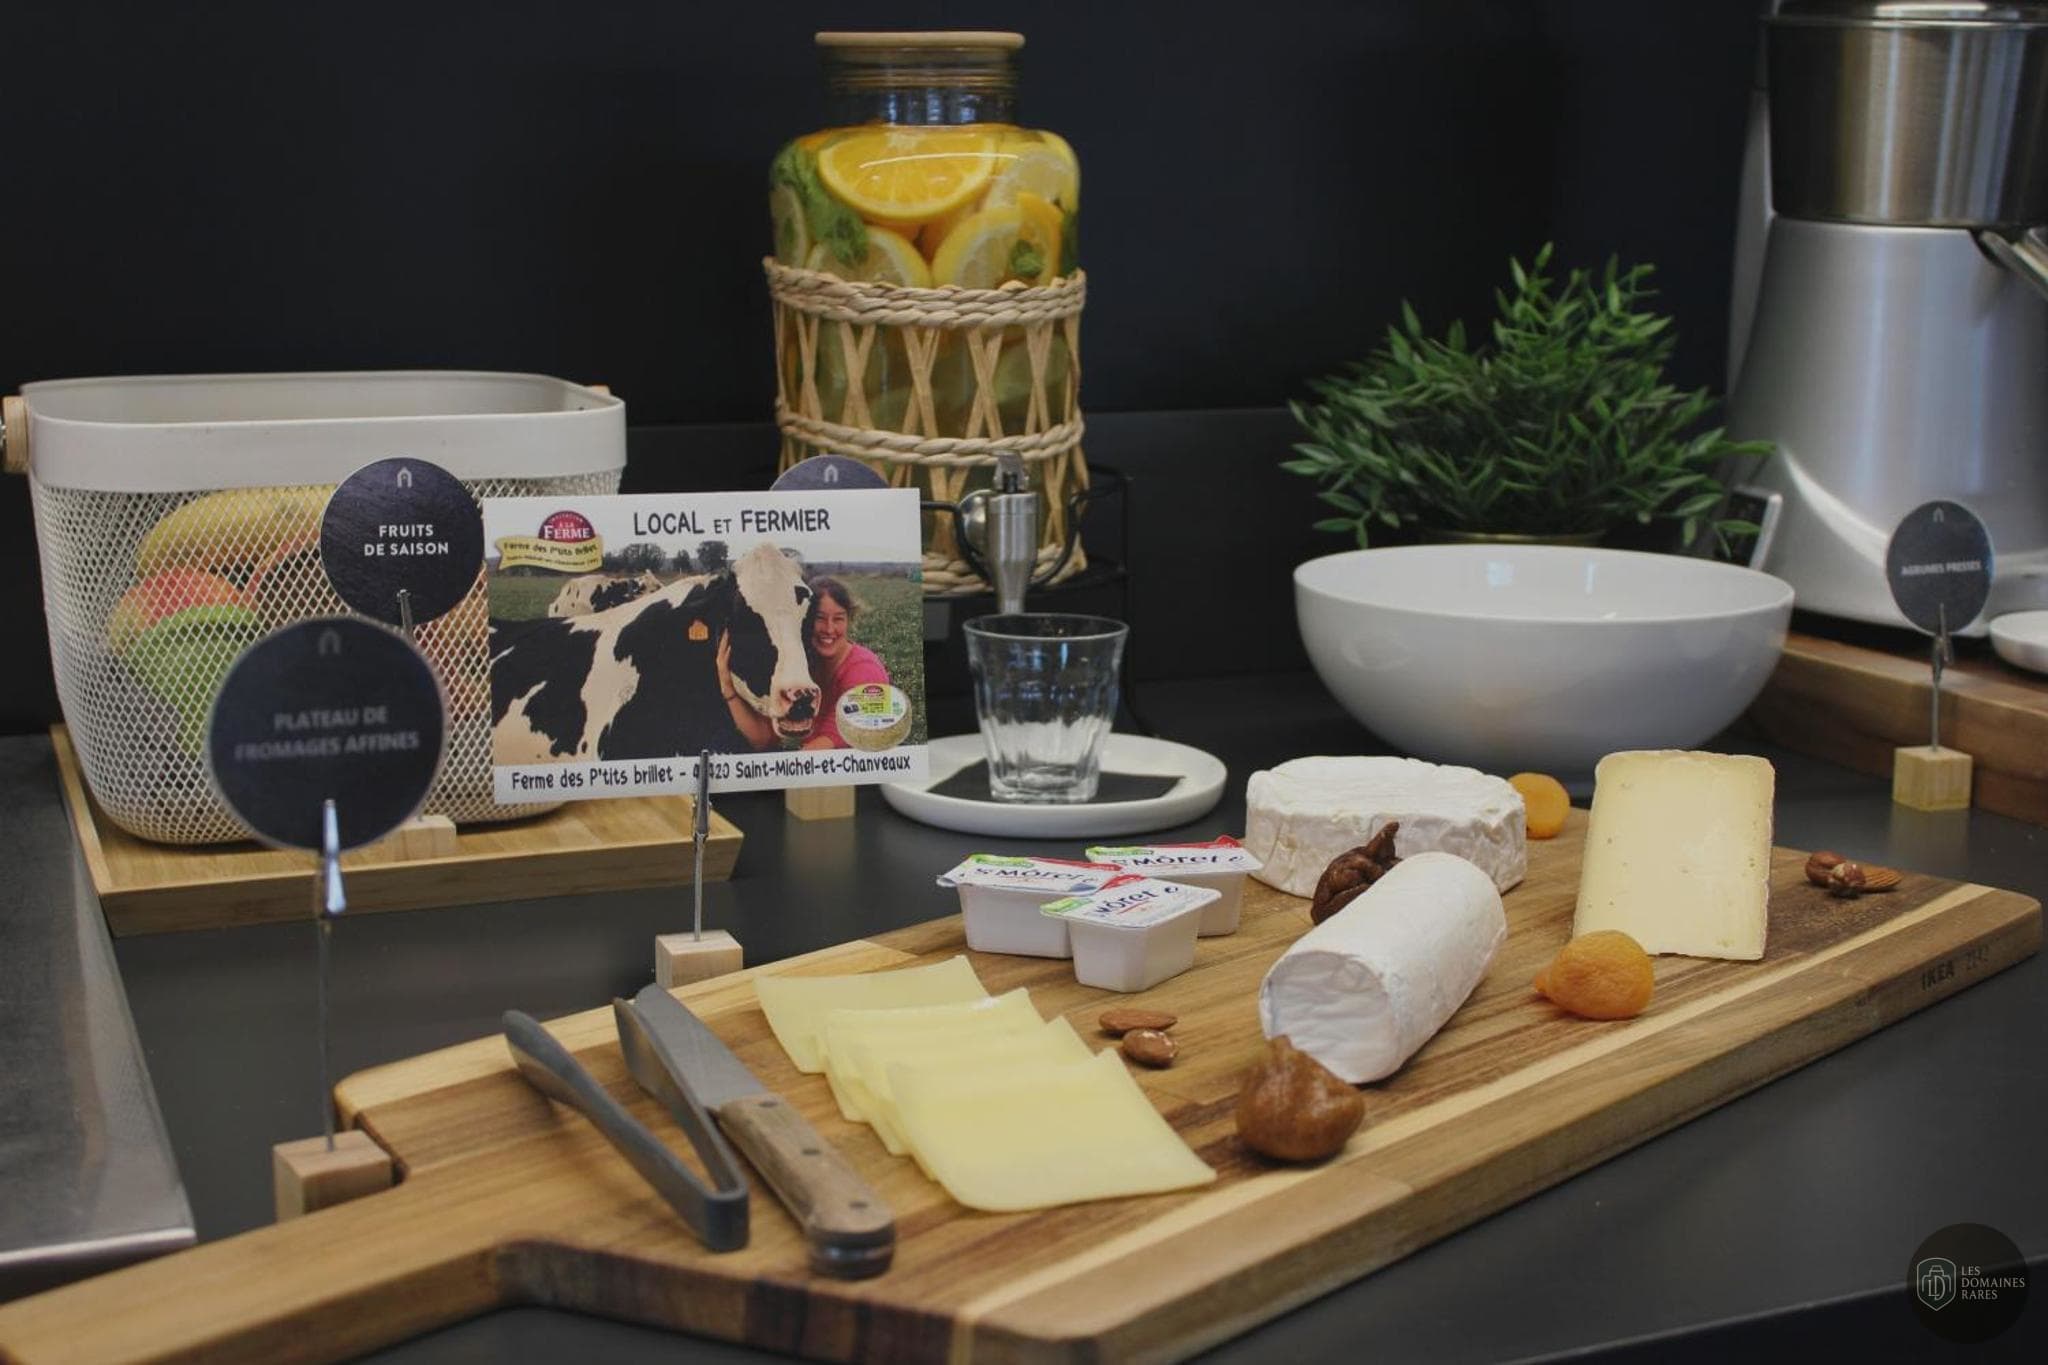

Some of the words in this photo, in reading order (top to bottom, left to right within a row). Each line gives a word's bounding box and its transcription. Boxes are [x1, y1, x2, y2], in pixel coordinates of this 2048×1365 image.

[379, 524, 434, 537] FRUITS
[544, 525, 590, 539] FERME
[634, 511, 704, 536] LOCAL
[714, 519, 732, 533] ET
[740, 509, 831, 533] FERMIER
[364, 543, 385, 556] DE
[390, 542, 449, 555] SAISON
[274, 707, 359, 731] PLATEAU
[363, 705, 388, 725] DE
[234, 737, 341, 761] FROMAGES
[512, 771, 555, 790] Ferme
[560, 768, 584, 788] des
[590, 767, 628, 786] P'tits
[634, 764, 674, 784] brillet
[736, 755, 911, 779] Saint-Michel-et-Chanveaux
